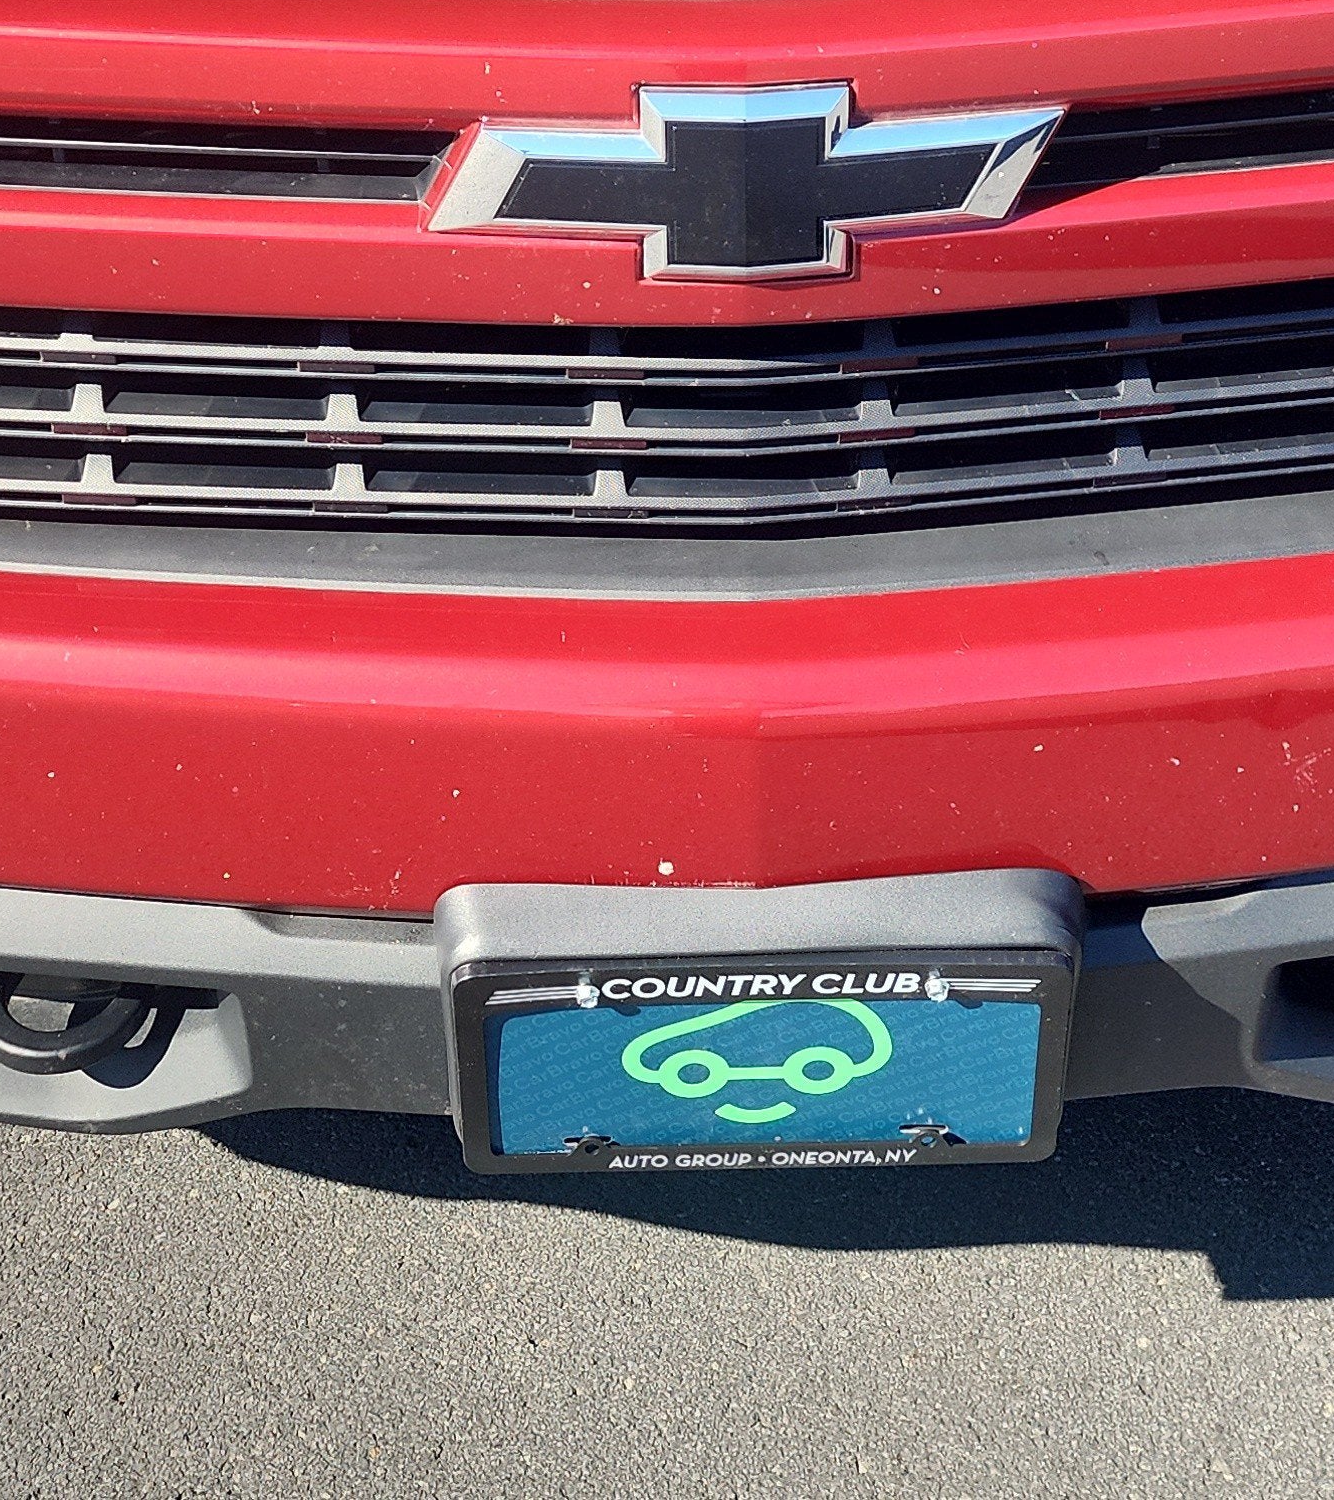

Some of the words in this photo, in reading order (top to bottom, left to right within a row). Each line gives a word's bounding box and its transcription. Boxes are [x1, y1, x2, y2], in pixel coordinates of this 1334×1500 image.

[601, 973, 807, 999] COUNTRY
[811, 972, 922, 995] CLUB
[608, 1154, 668, 1168] AUTO
[675, 1153, 752, 1167] GROUP
